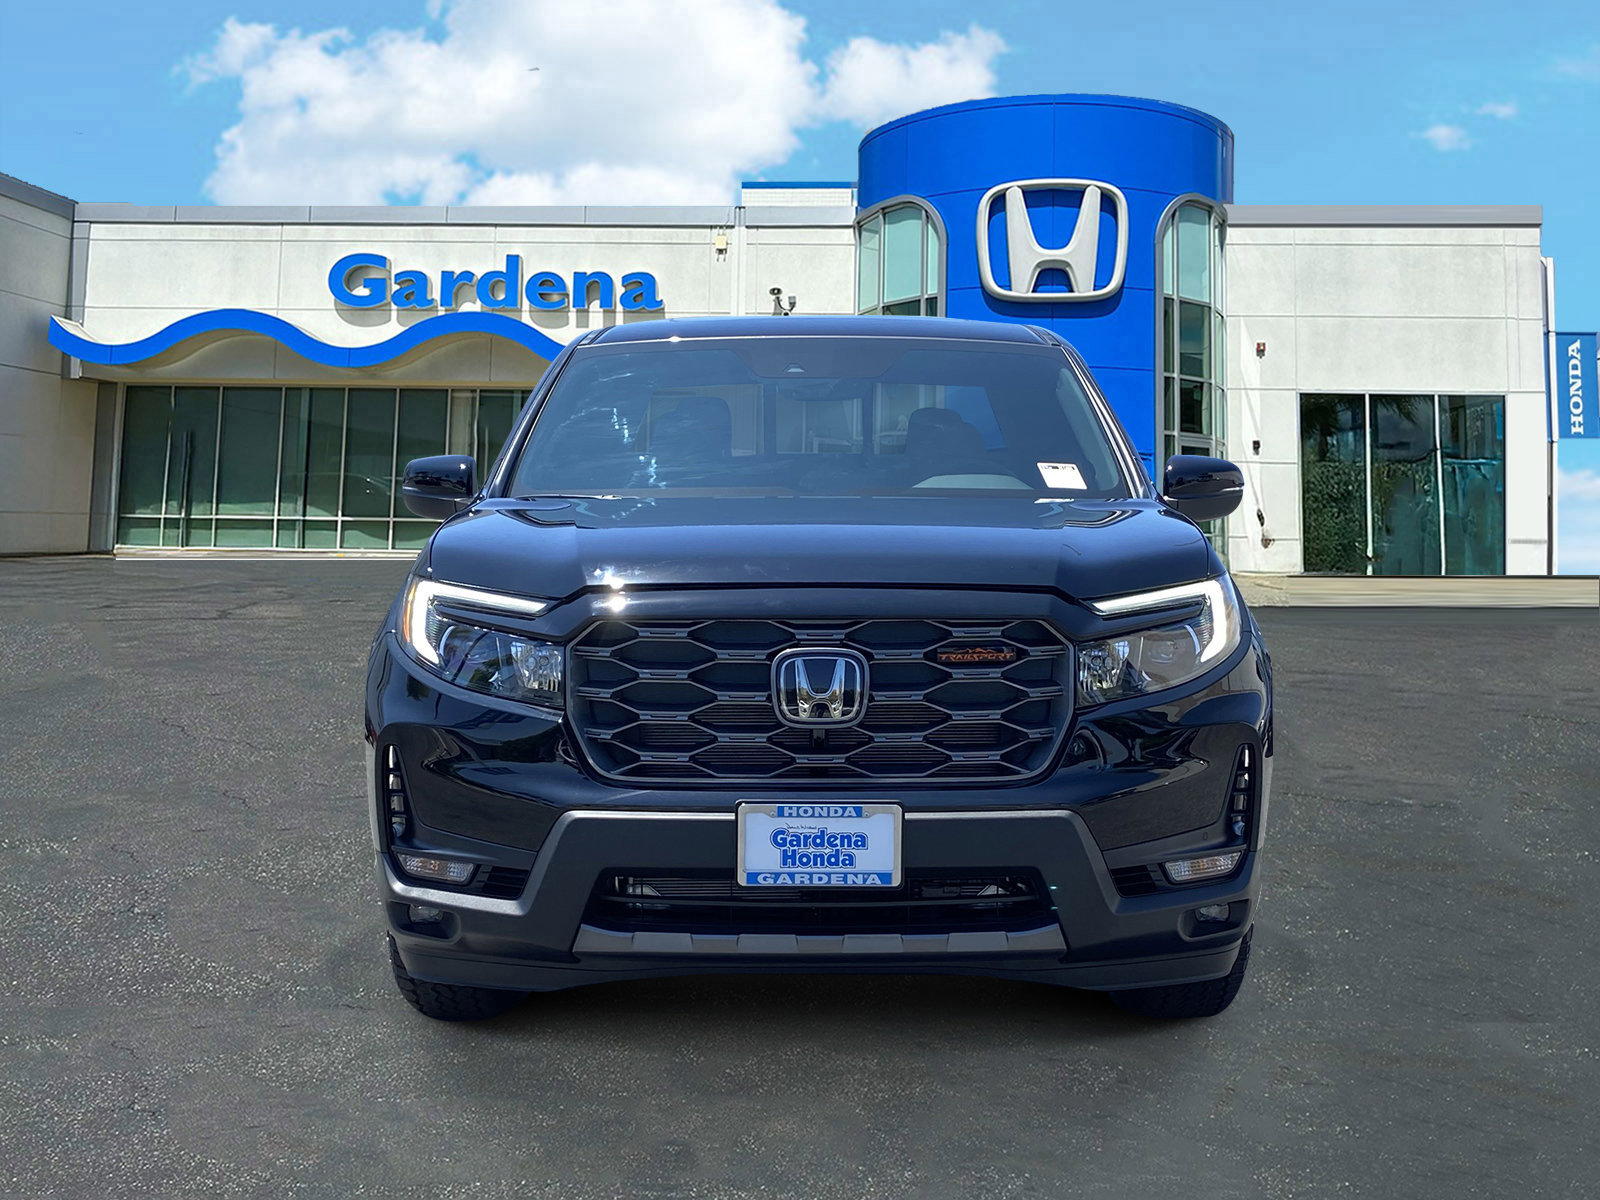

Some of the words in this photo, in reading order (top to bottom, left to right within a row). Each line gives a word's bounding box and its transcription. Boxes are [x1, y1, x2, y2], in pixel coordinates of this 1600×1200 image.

[328, 252, 664, 311] Gardena
[1567, 339, 1584, 434] HONDA
[783, 806, 857, 817] HONDA
[770, 828, 868, 850] Gardena
[780, 849, 856, 868] Honda
[757, 873, 882, 885] GARDENA
